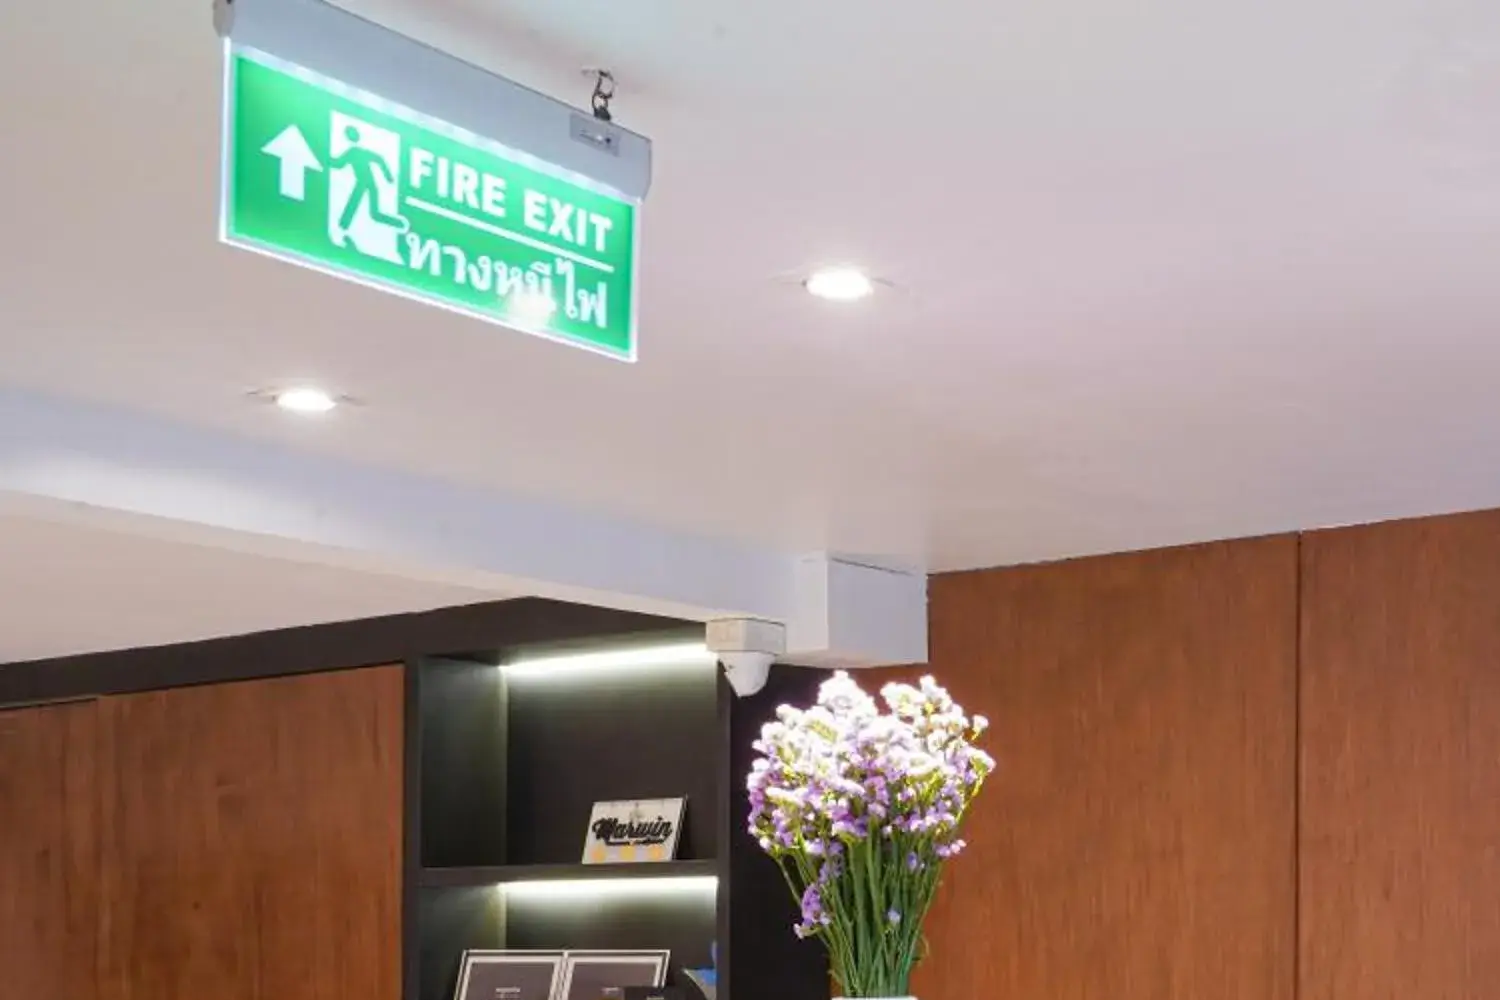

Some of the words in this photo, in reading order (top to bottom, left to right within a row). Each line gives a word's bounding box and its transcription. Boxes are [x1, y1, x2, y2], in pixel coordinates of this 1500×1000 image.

[409, 146, 507, 218] FIRE
[523, 188, 613, 253] EXIT
[592, 815, 673, 846] Marwin
